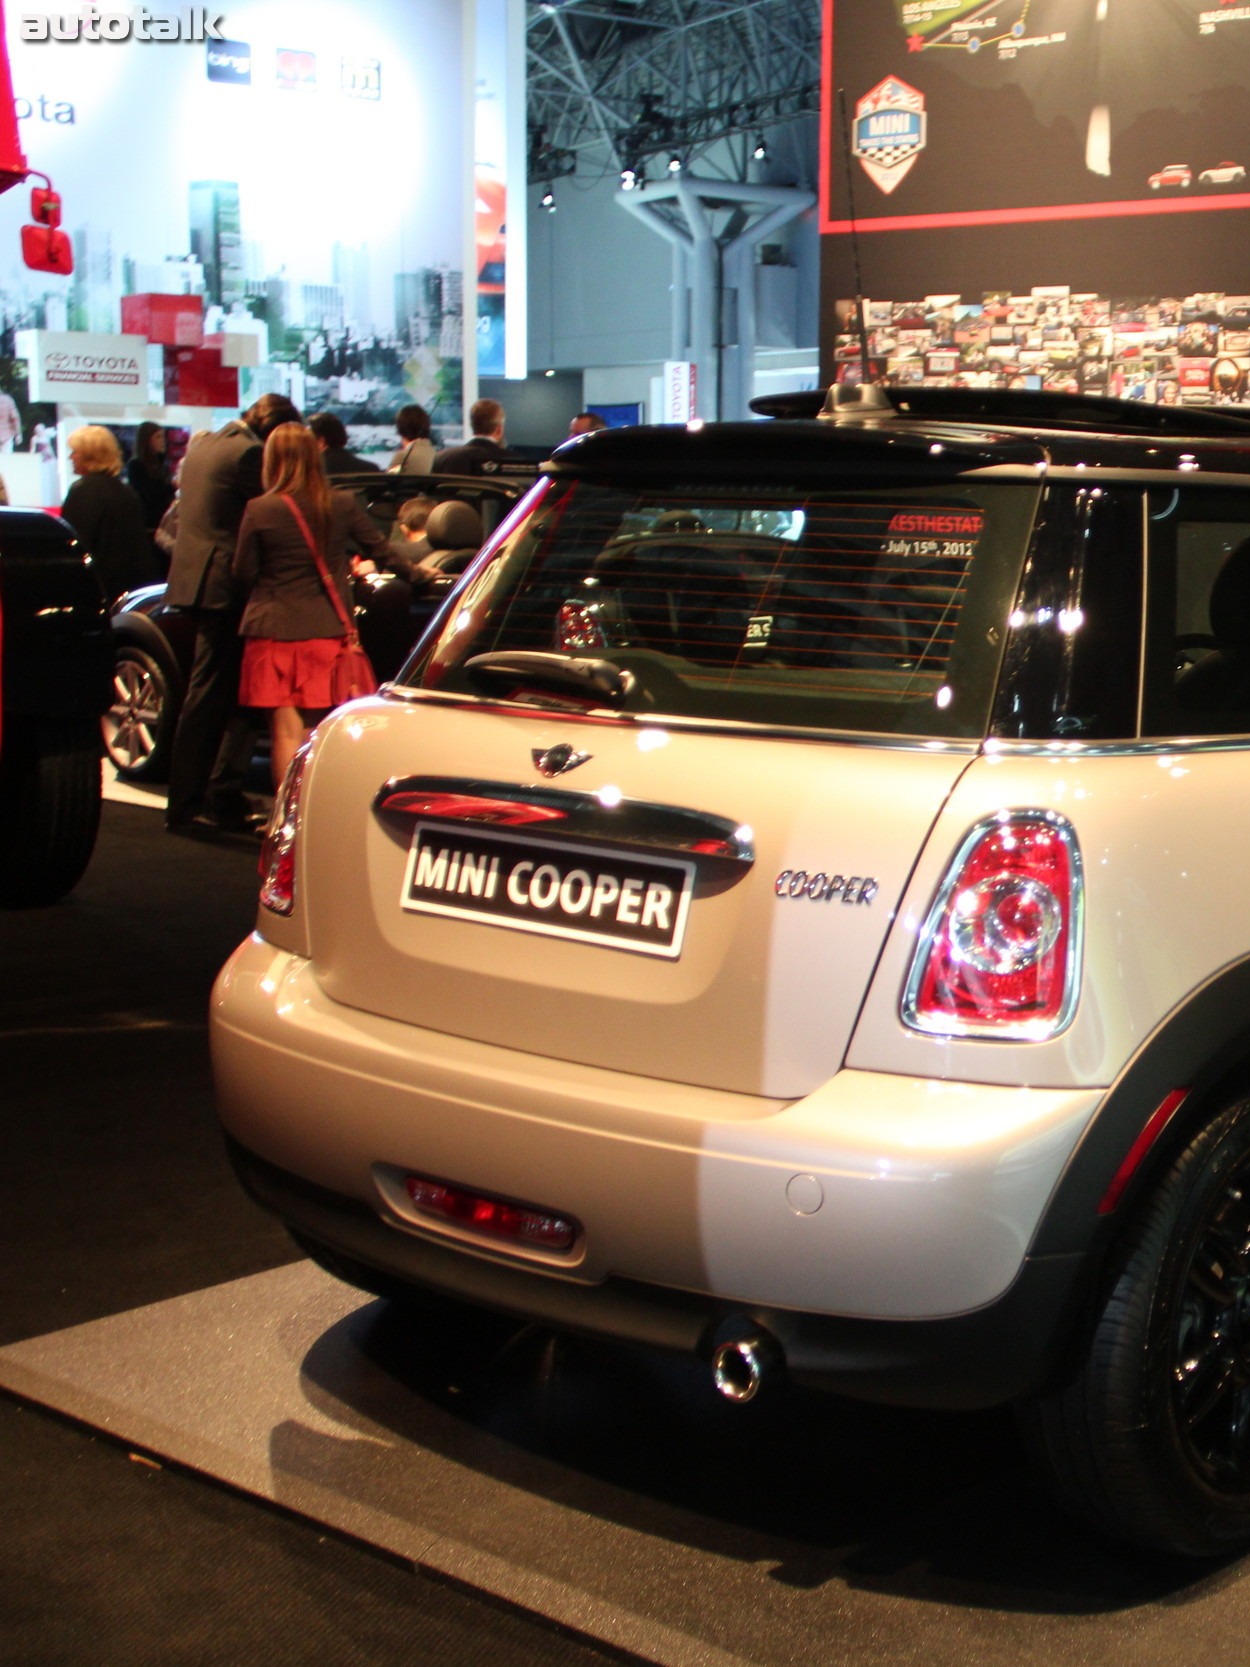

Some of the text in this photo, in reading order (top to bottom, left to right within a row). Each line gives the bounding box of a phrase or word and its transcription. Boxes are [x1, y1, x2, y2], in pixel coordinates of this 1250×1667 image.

[869, 113, 910, 136] MINI
[73, 355, 139, 369] TOYOTA
[886, 540, 912, 556] July
[942, 542, 973, 556] 2012
[414, 845, 672, 929] MINI COOPER
[775, 869, 879, 906] COOPER
